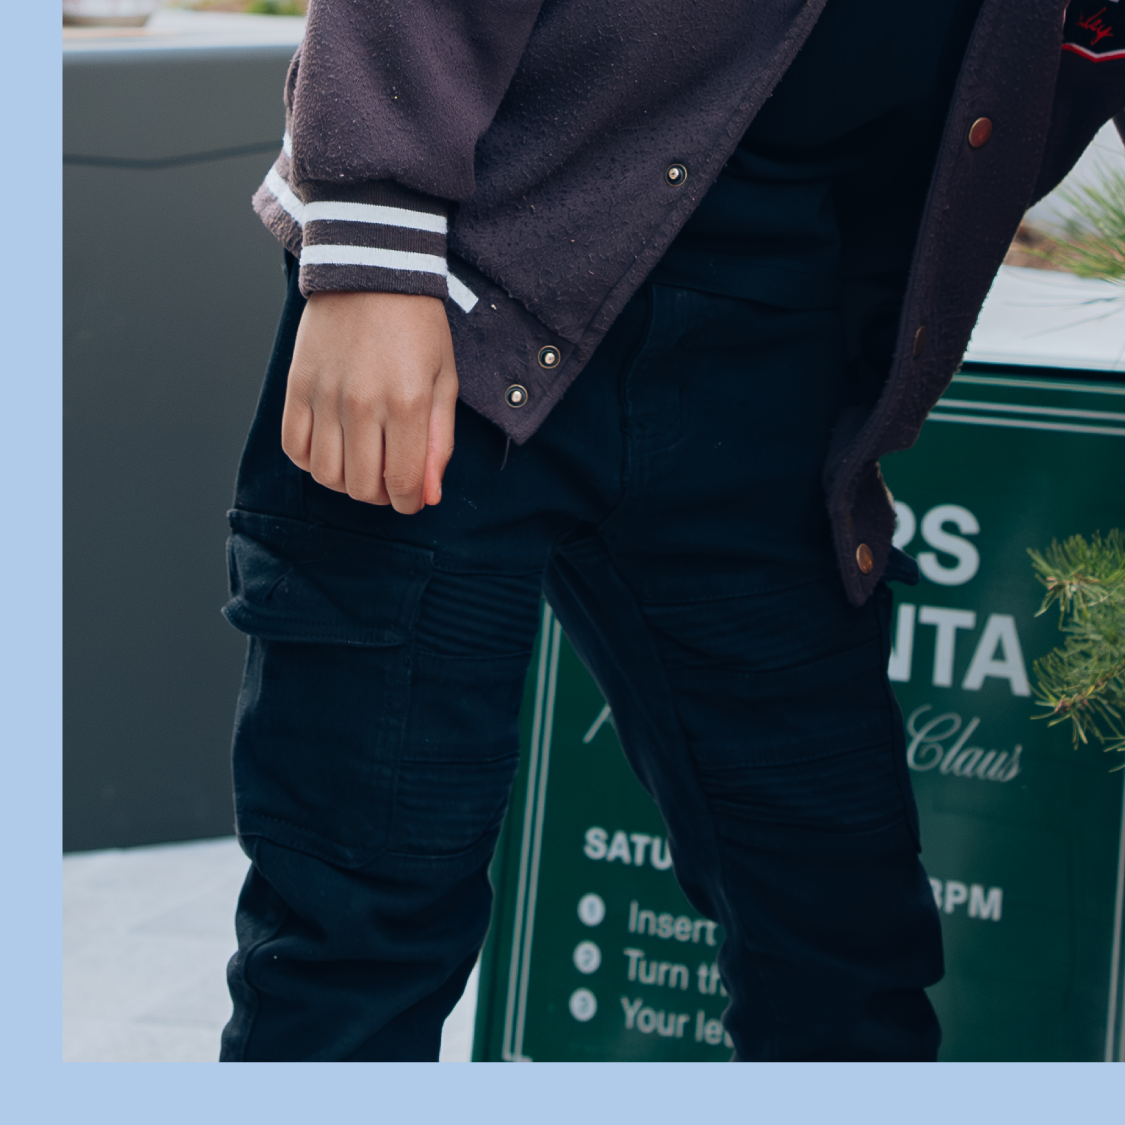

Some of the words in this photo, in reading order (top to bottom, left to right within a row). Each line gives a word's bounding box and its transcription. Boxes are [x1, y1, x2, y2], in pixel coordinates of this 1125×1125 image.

[907, 703, 1022, 782] Claus
[628, 900, 718, 947] Insert
[623, 947, 689, 991] Turn
[620, 996, 690, 1038] Your
